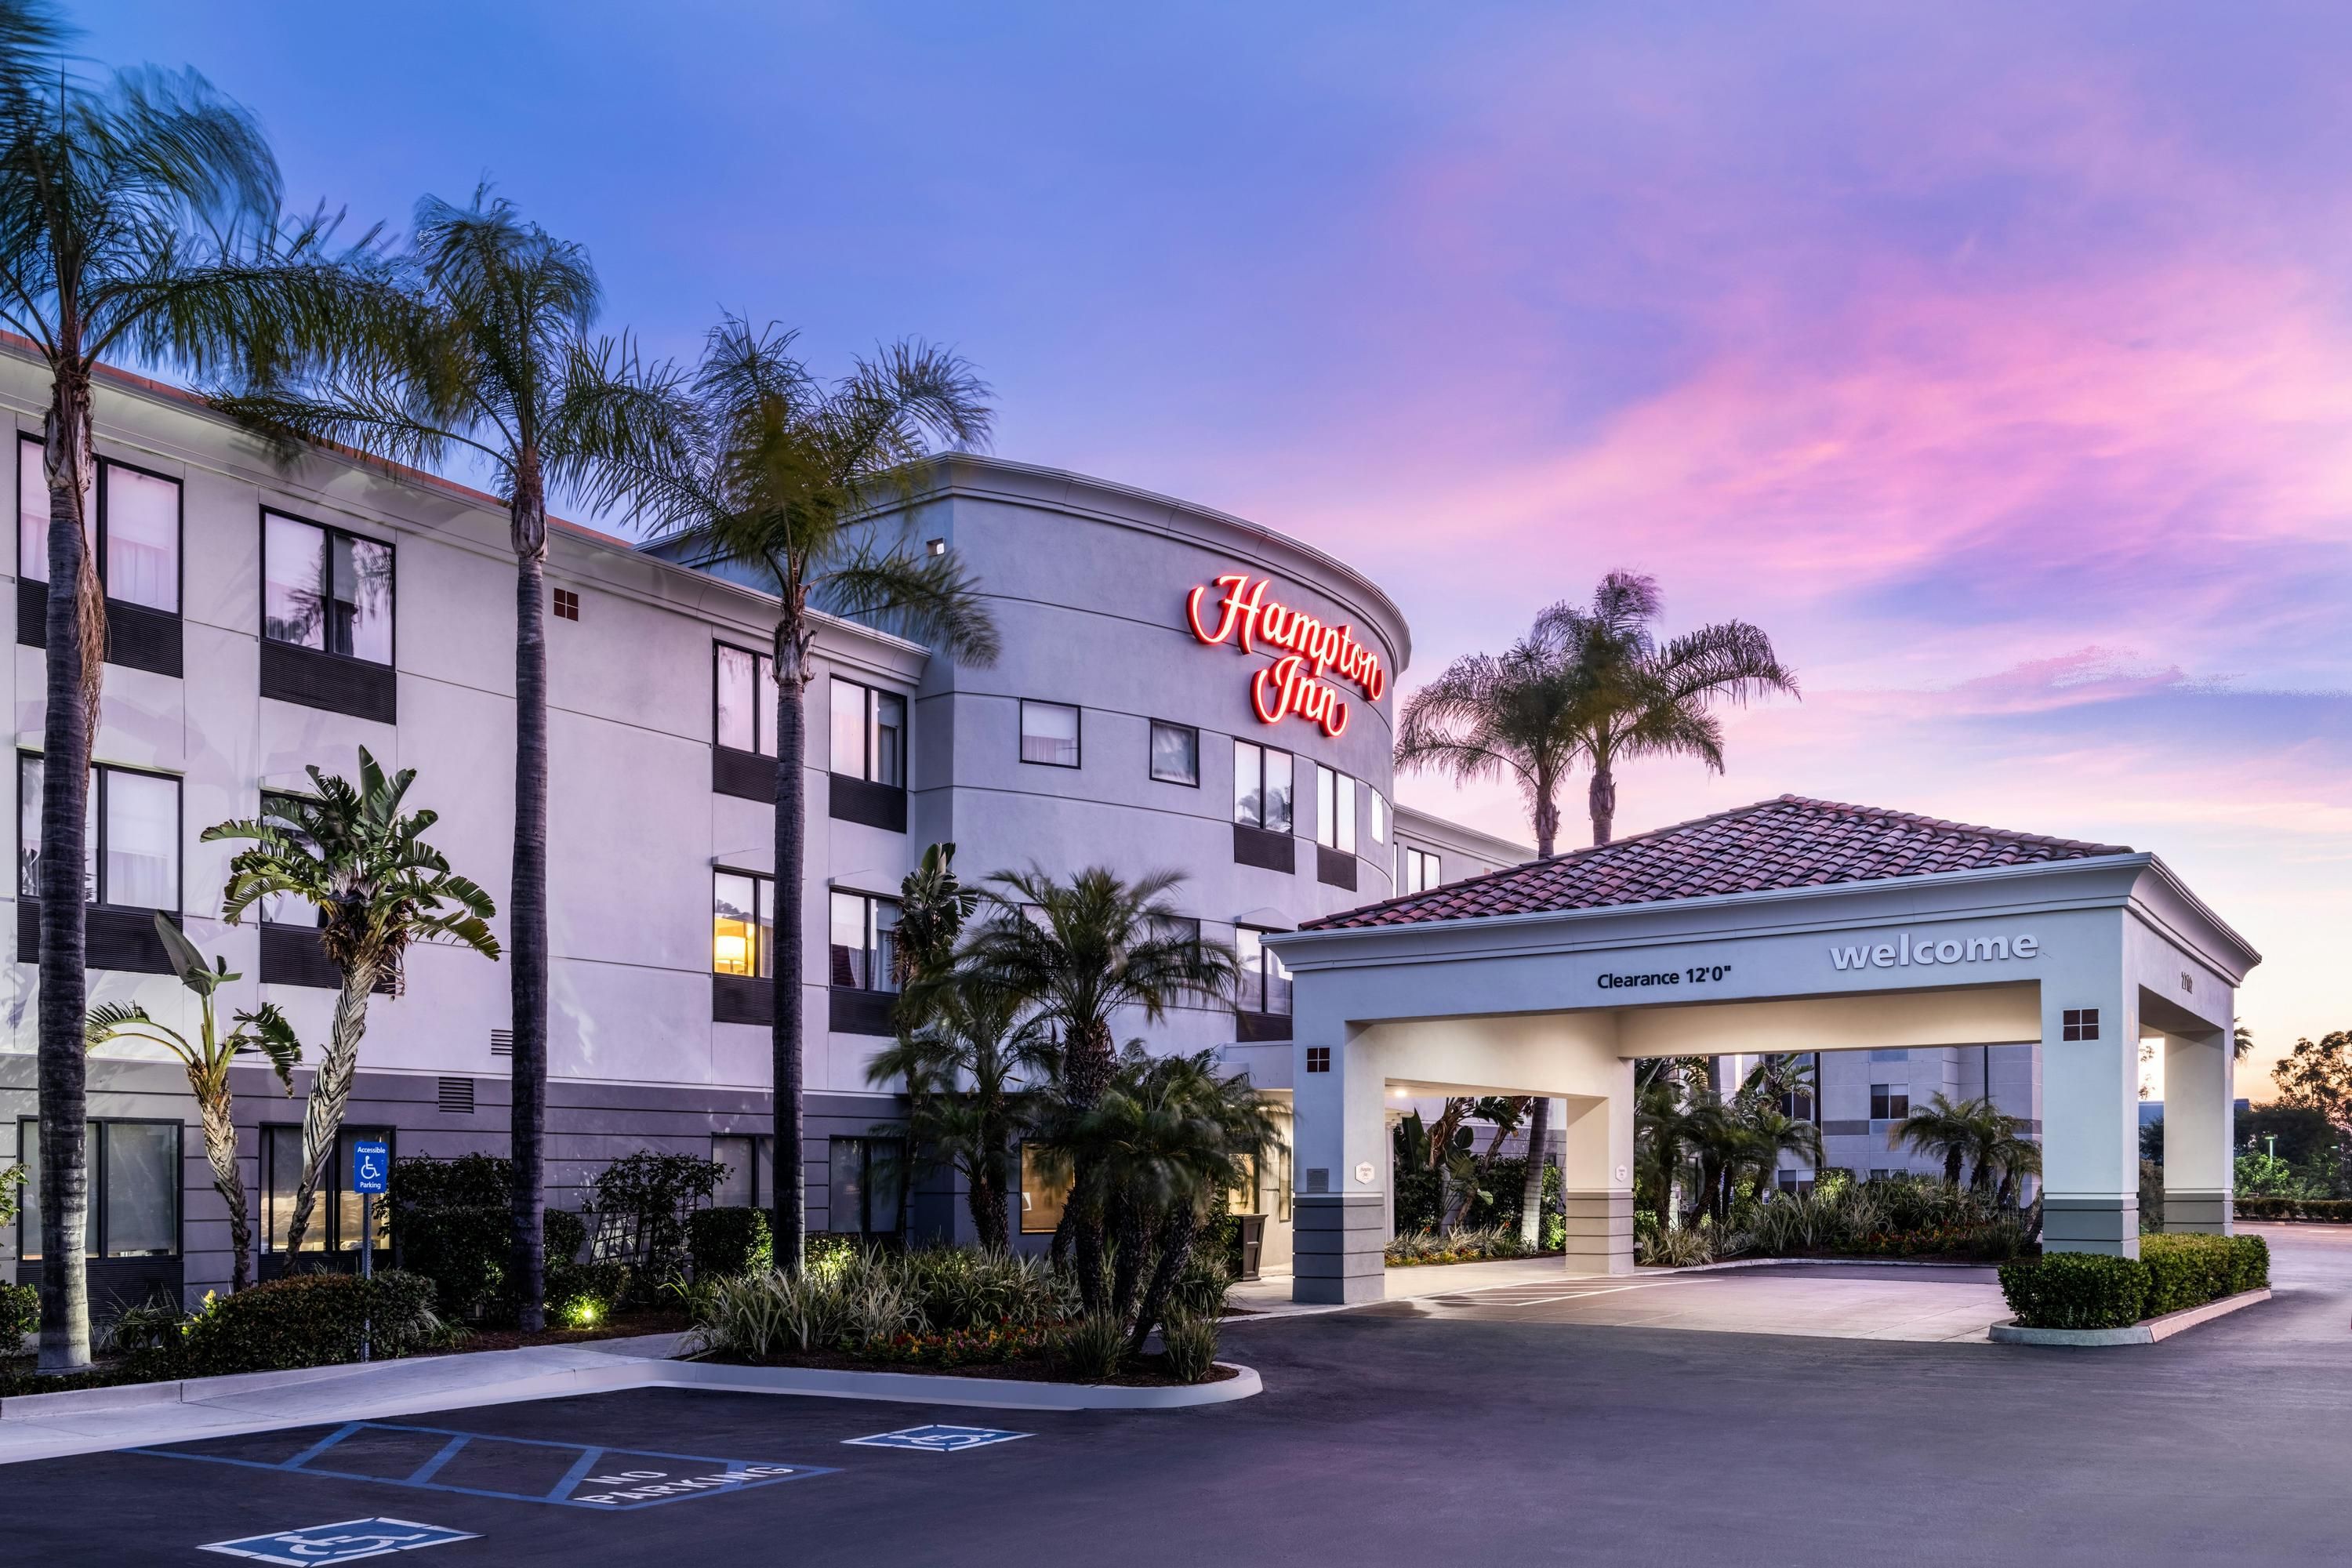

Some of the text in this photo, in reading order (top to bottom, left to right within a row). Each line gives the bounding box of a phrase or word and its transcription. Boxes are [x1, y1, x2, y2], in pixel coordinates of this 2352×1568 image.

[1186, 575, 1385, 702] Hampton
[1250, 653, 1349, 738] Inn
[1829, 933, 2038, 971] welcome
[1597, 972, 1680, 989] Clearance
[360, 1181, 381, 1189] Parking
[573, 1467, 794, 1504] PARKING
[583, 1470, 668, 1485] NO
